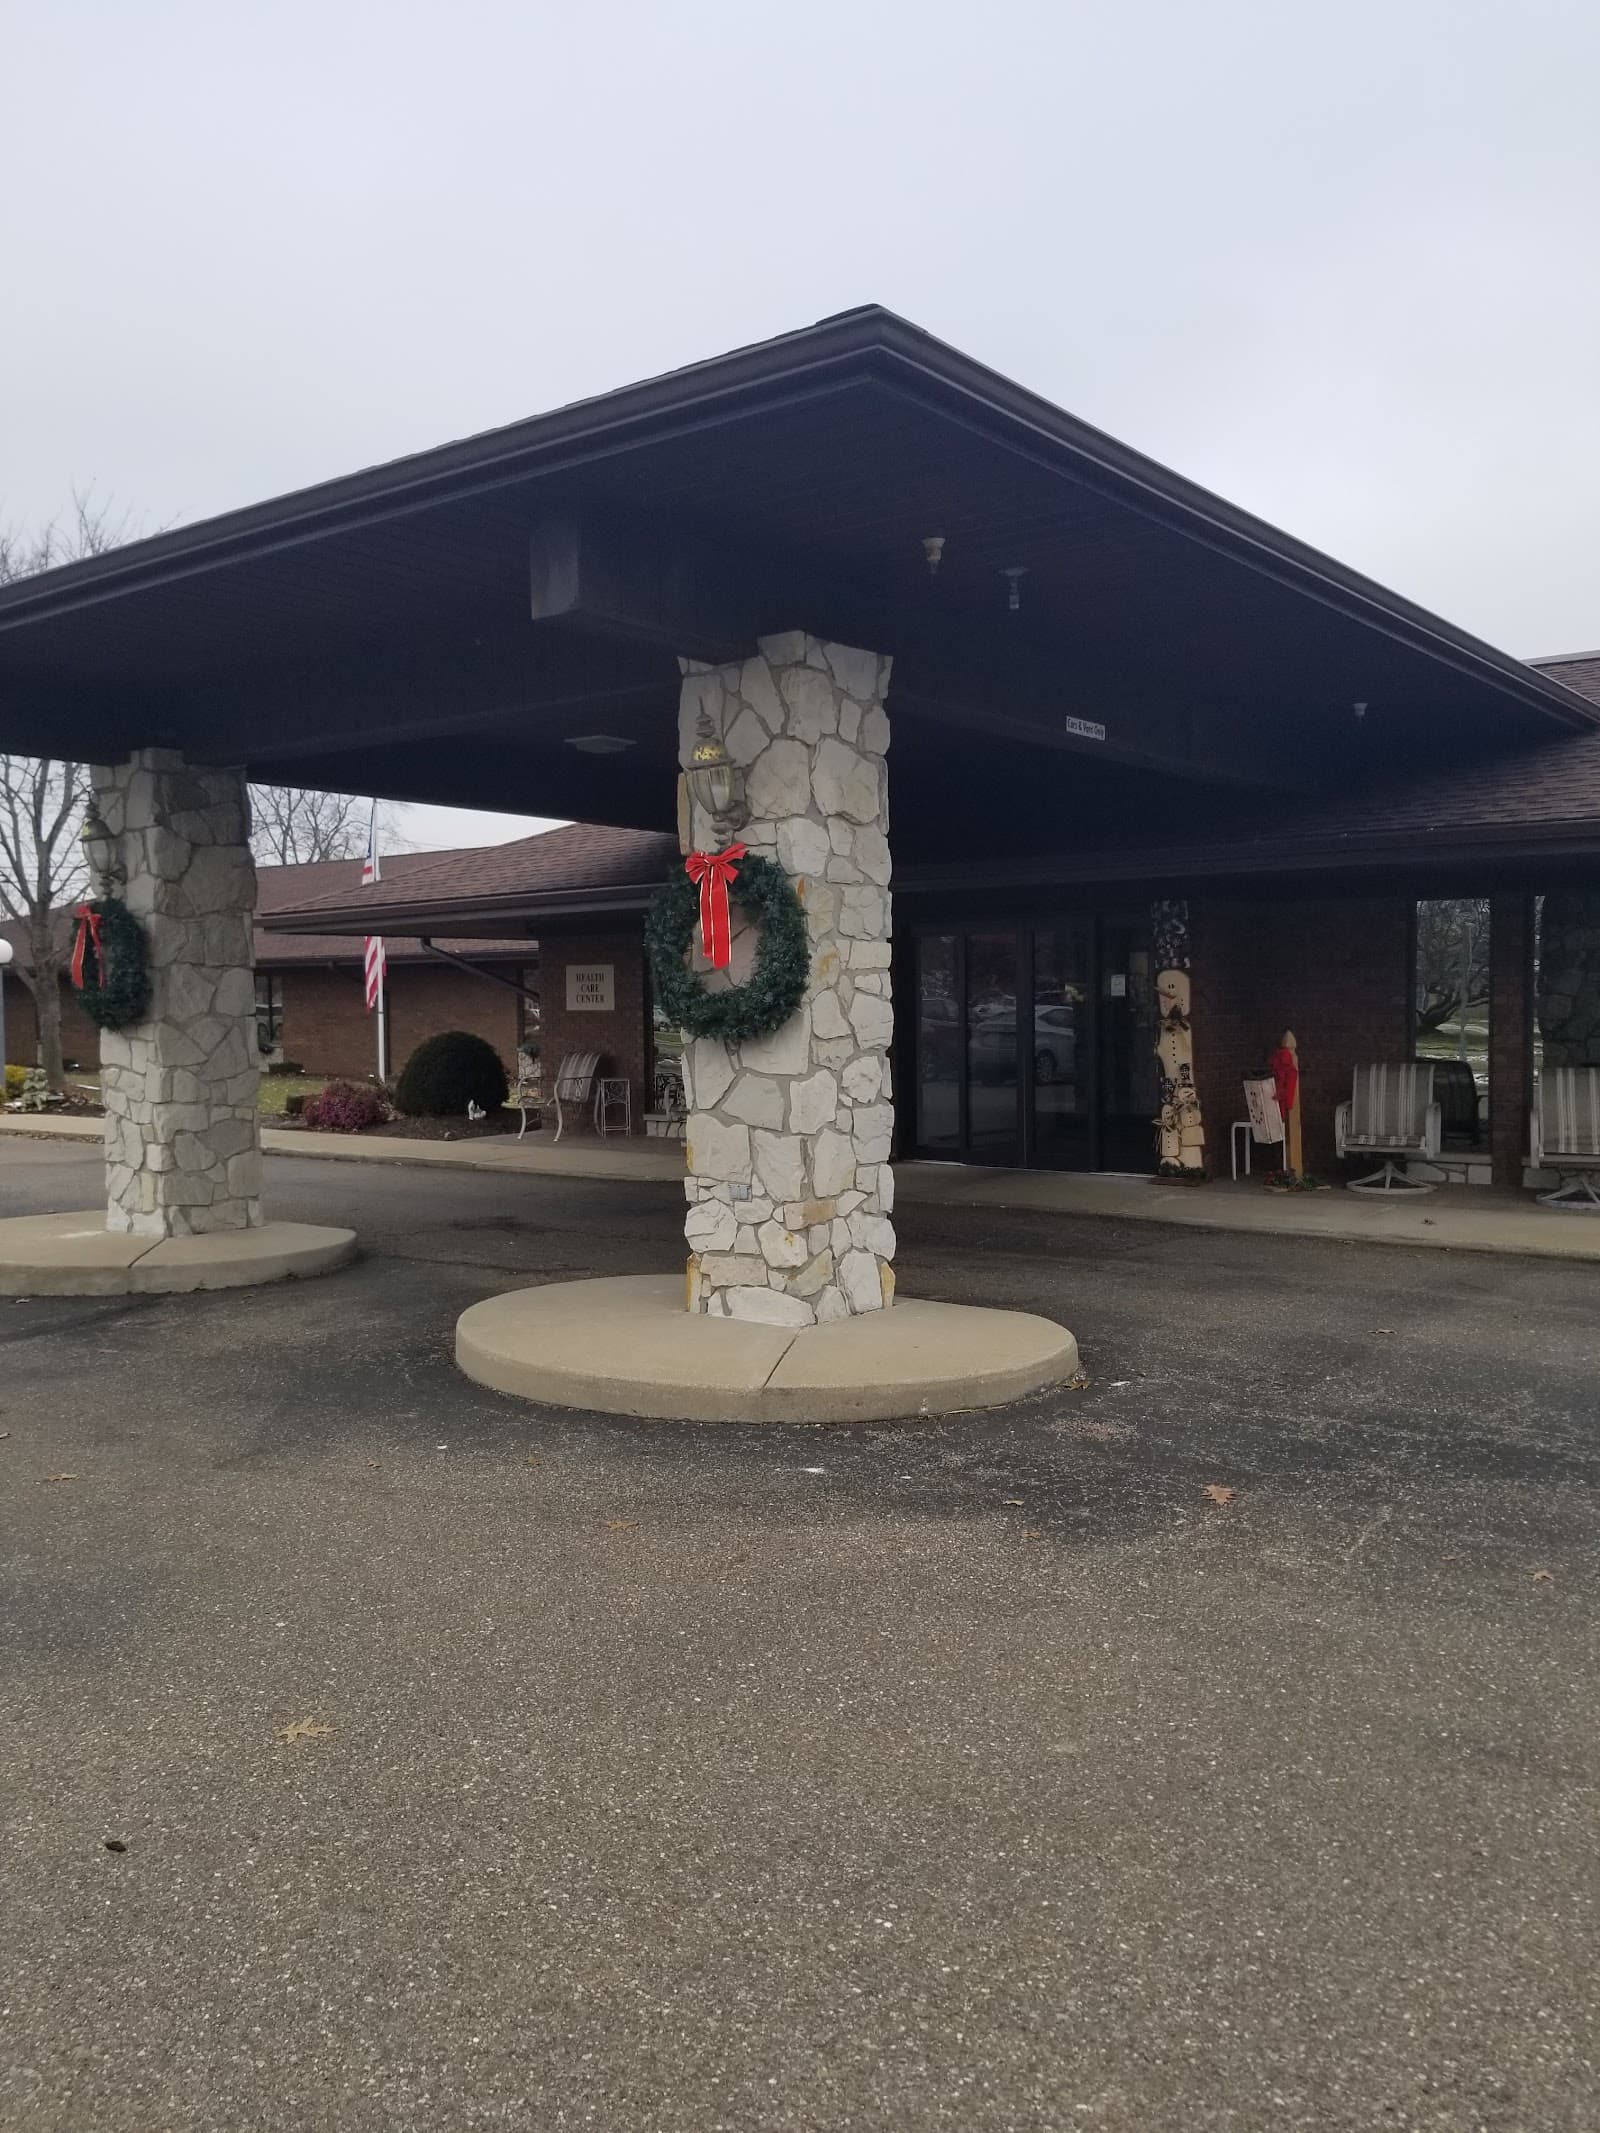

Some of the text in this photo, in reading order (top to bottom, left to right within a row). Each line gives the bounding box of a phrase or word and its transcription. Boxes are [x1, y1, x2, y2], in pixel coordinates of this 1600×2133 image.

[1067, 718, 1104, 738] Cars & Vans Only
[576, 972, 604, 983] HEALTH
[580, 983, 600, 993] CARE
[576, 994, 604, 1004] CENTER
